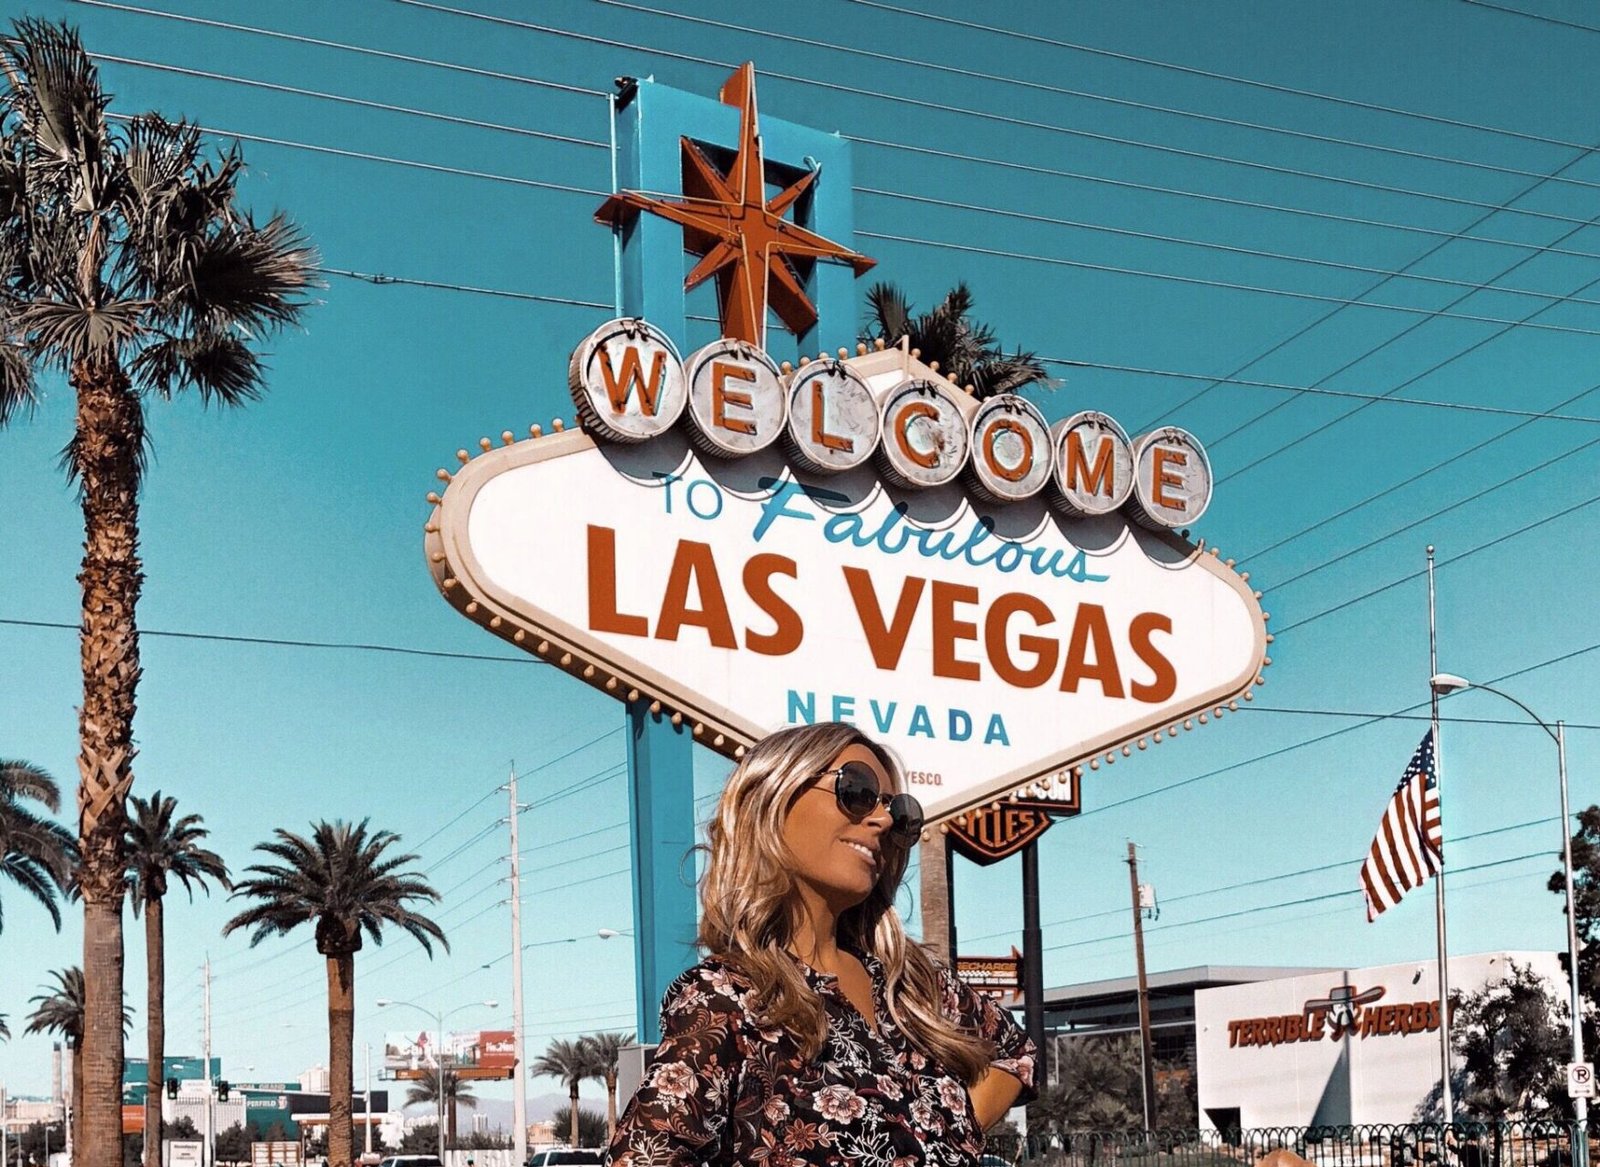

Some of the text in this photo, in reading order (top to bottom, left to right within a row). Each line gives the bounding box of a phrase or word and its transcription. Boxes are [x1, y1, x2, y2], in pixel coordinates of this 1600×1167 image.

[597, 345, 1188, 512] WELCOME
[652, 471, 1110, 583] TO Fabulous
[587, 524, 1177, 704] LAS VEGAS
[787, 689, 1011, 746] NEVADA
[957, 962, 1017, 970] ECHARGE
[1228, 1009, 1326, 1049] TERRIBLE
